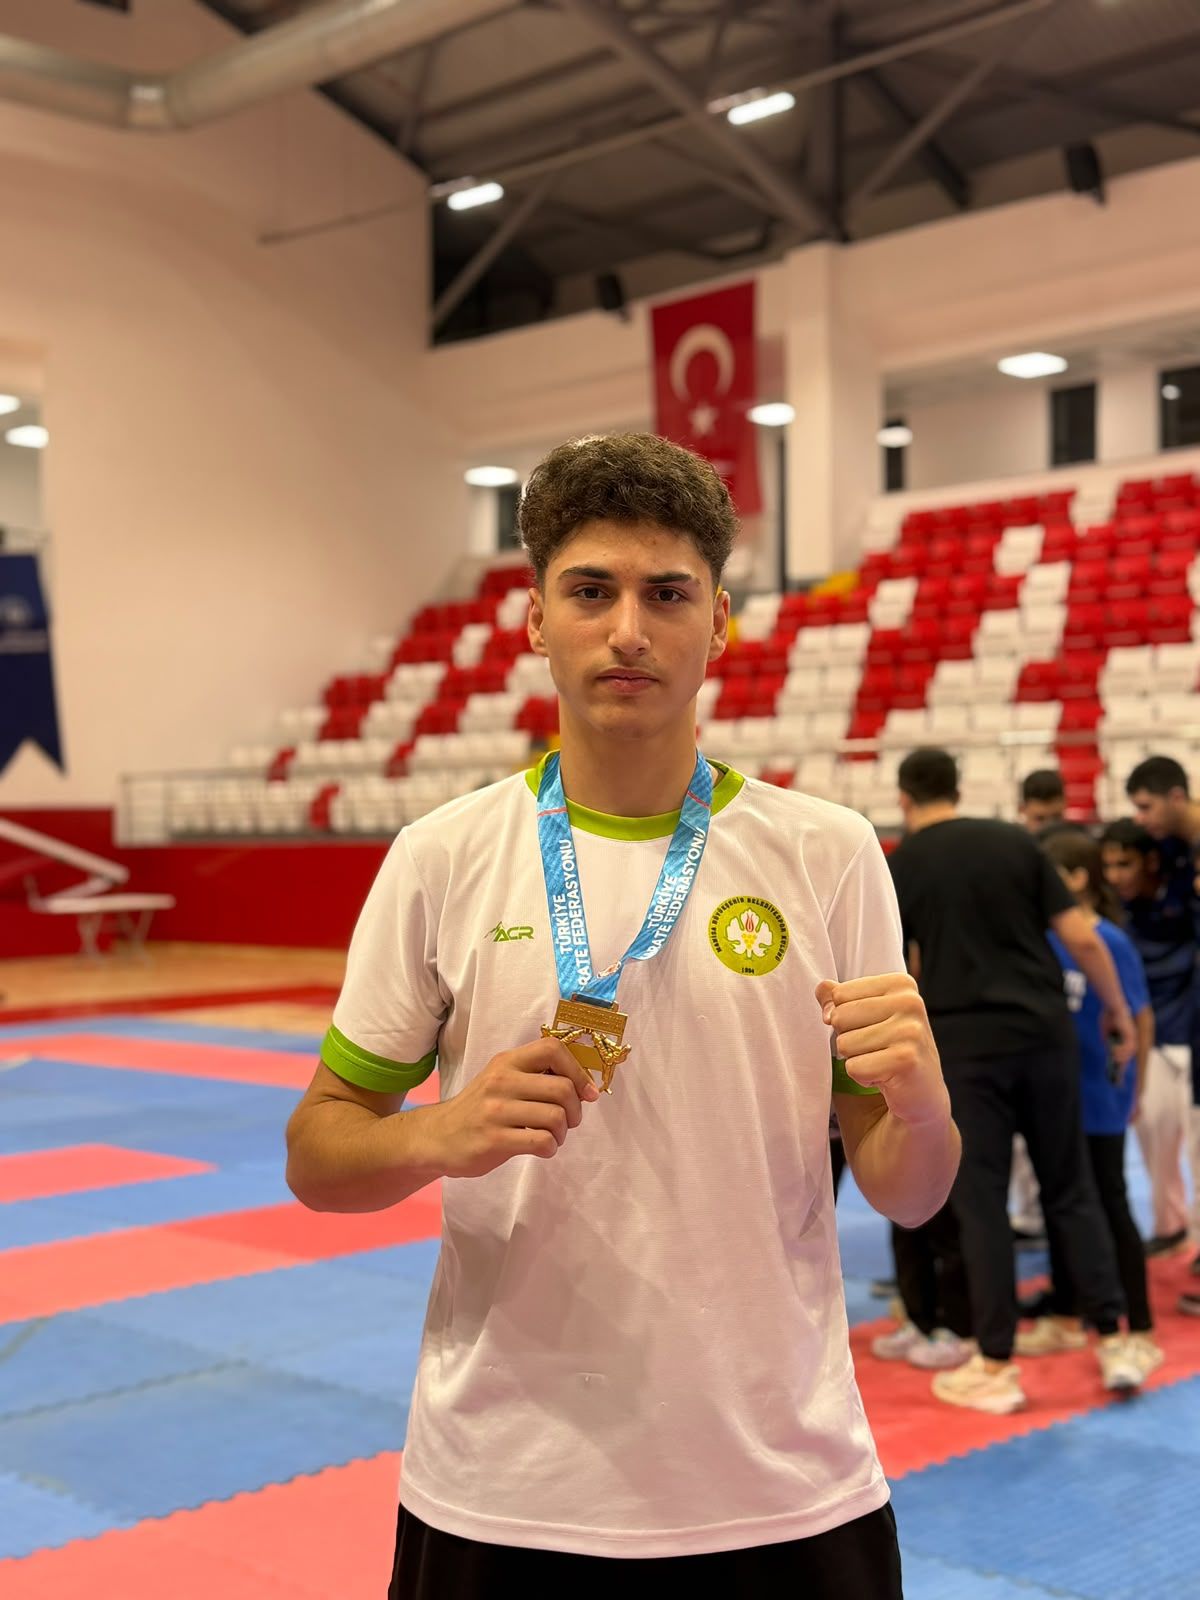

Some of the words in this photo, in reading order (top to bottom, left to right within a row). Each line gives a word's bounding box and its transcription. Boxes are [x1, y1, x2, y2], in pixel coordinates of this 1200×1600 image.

[559, 839, 588, 946] FEDERASYONU
[647, 874, 678, 929] TÜRKİYE
[663, 826, 706, 922] FEDERASYONU
[552, 894, 573, 956] TÜRKİYE
[574, 948, 592, 992] RATE
